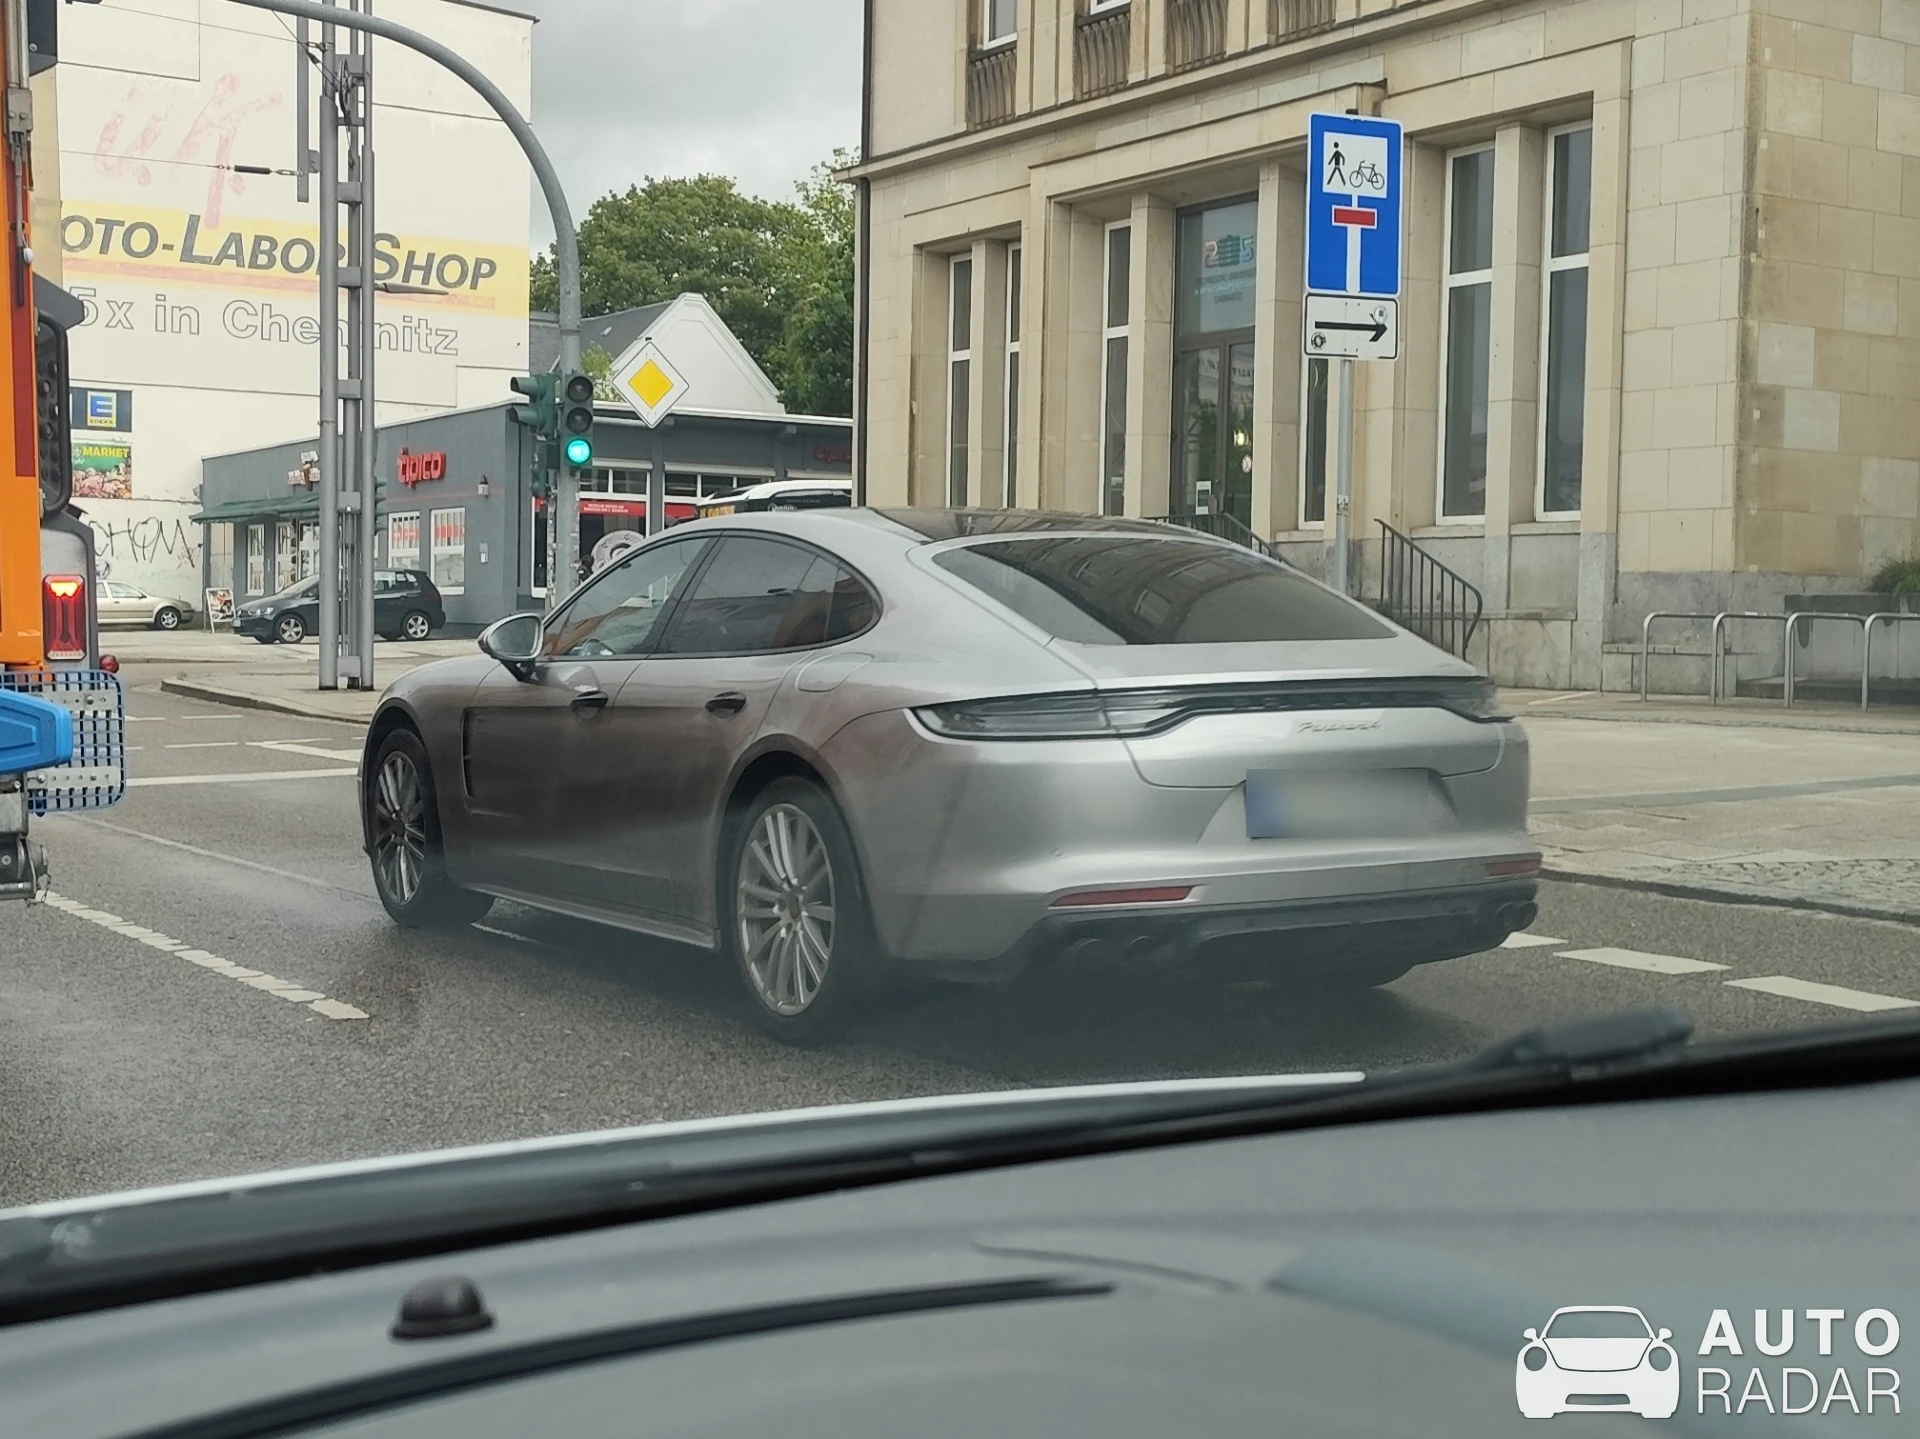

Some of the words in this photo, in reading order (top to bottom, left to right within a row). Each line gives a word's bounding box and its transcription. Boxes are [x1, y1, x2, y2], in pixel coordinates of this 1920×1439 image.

[155, 294, 200, 335] in
[82, 445, 130, 458] MARKET
[396, 447, 446, 490] tipico
